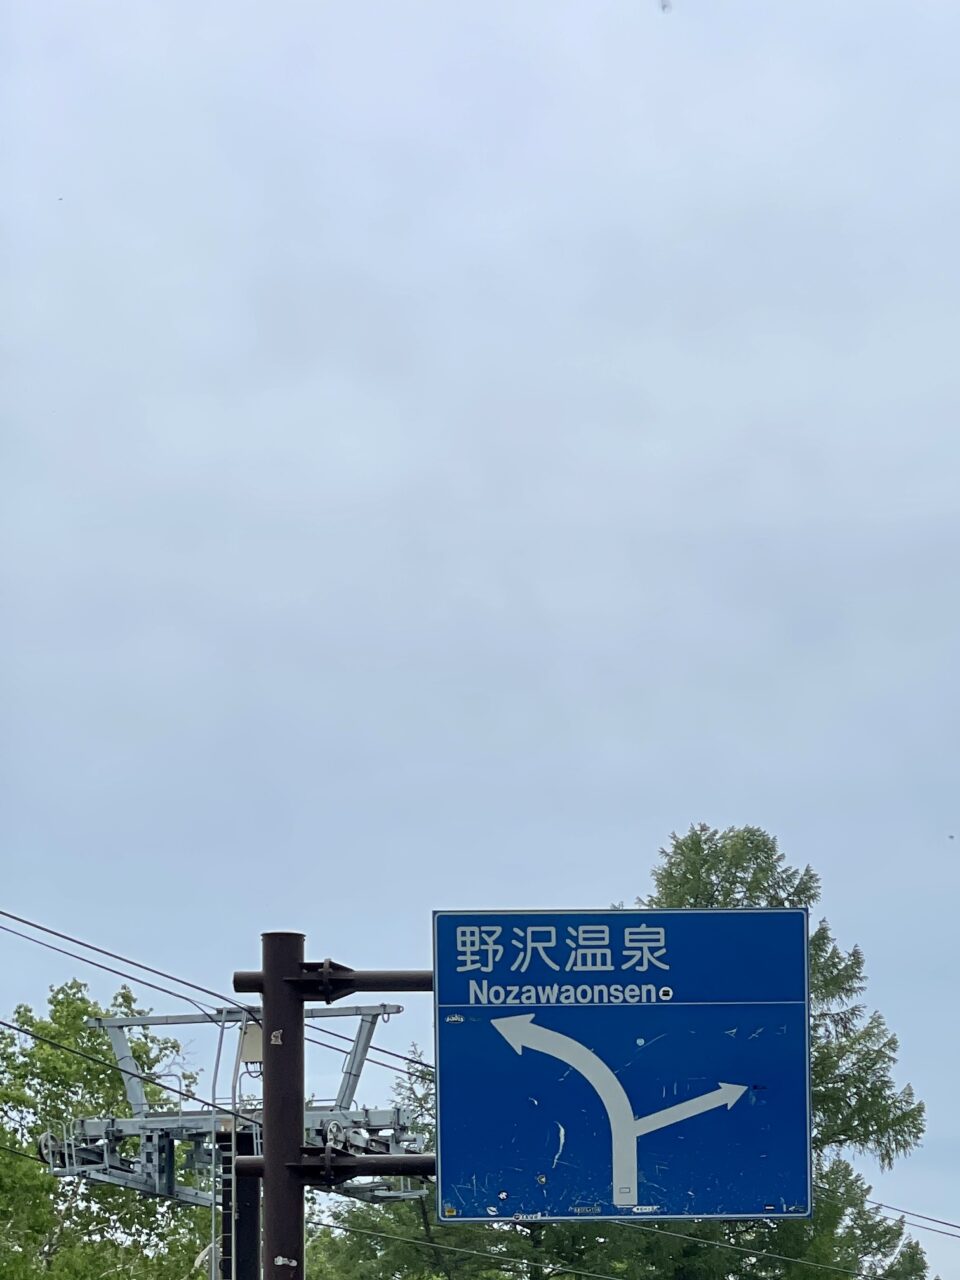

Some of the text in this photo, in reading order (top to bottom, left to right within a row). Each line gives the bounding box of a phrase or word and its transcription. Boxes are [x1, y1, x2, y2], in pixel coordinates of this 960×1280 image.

[456, 923, 670, 973] 野沢温泉
[469, 979, 657, 1005] Nozawaonsen
